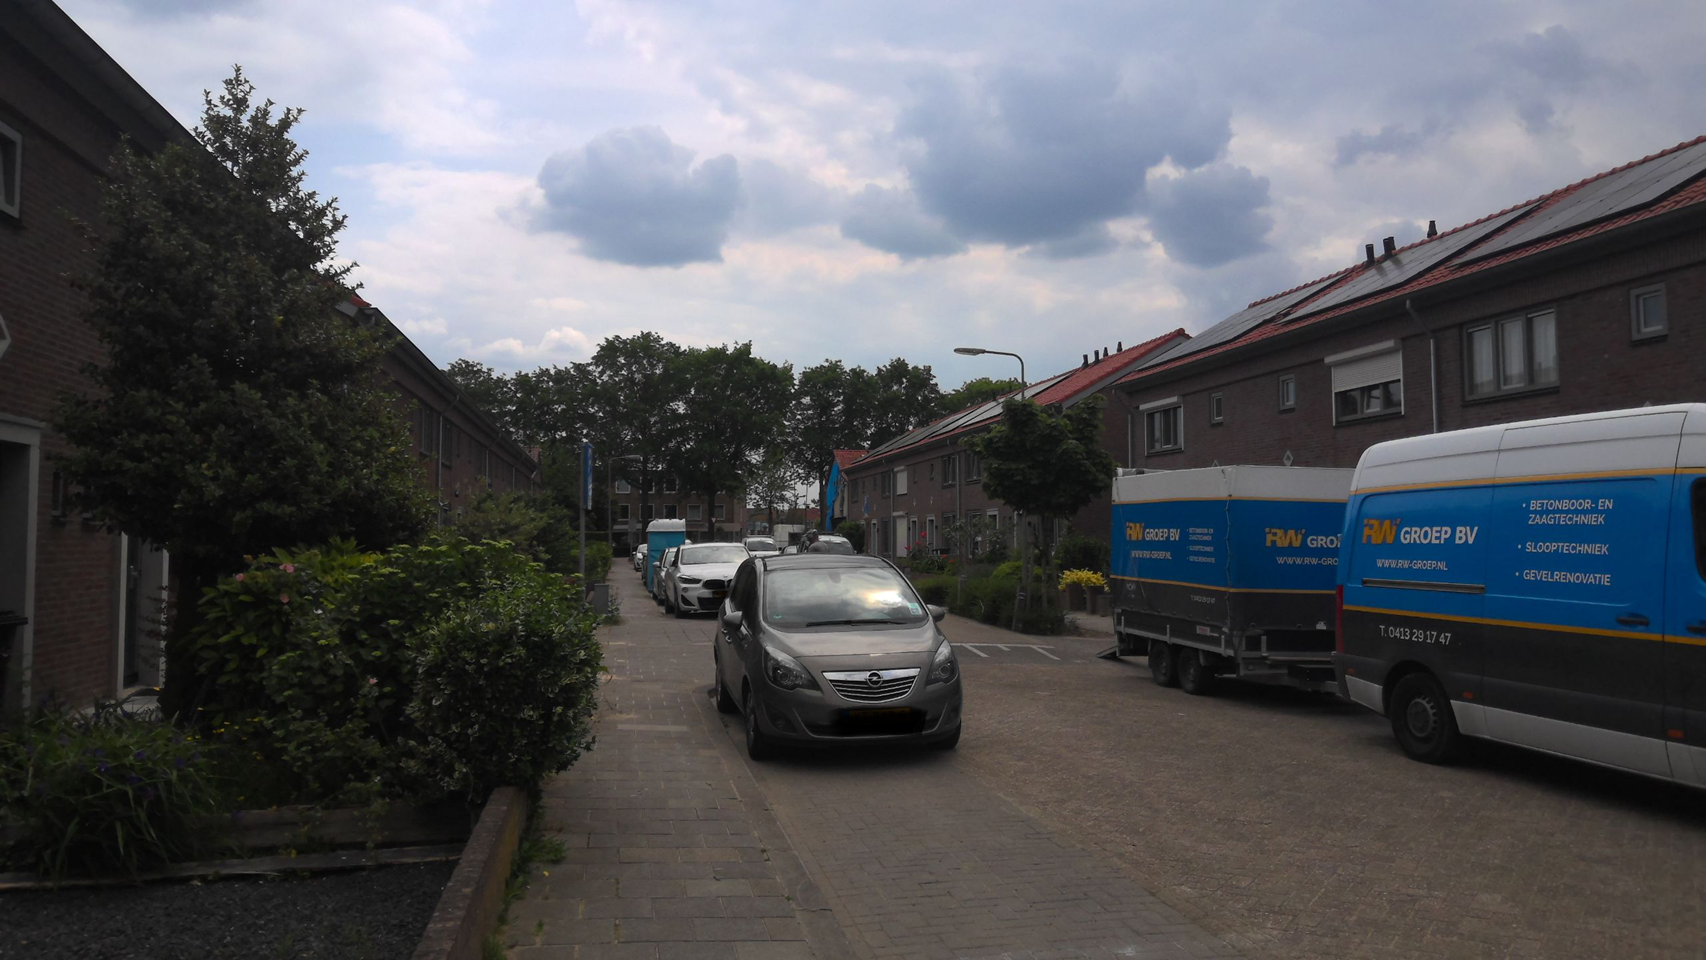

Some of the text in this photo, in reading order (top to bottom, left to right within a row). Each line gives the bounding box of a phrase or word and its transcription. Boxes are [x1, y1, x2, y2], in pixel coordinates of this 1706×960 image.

[1529, 499, 1614, 511] BETONBOOR- EN
[1528, 514, 1606, 525] ZAAGTECHNIEK
[1144, 528, 1169, 541] GROEP
[1169, 528, 1180, 541] BV
[1400, 526, 1452, 544] GROEP
[1455, 526, 1479, 544] BV
[1525, 541, 1610, 556] SLOOPTECHNIEK
[1276, 556, 1339, 566] WWW.RW-GRO
[1376, 559, 1448, 571] WWW.RW-GROEP.NL
[1523, 569, 1611, 586] GEVELRENOVATIE
[1379, 625, 1451, 645] T. 0413 29 17 47
